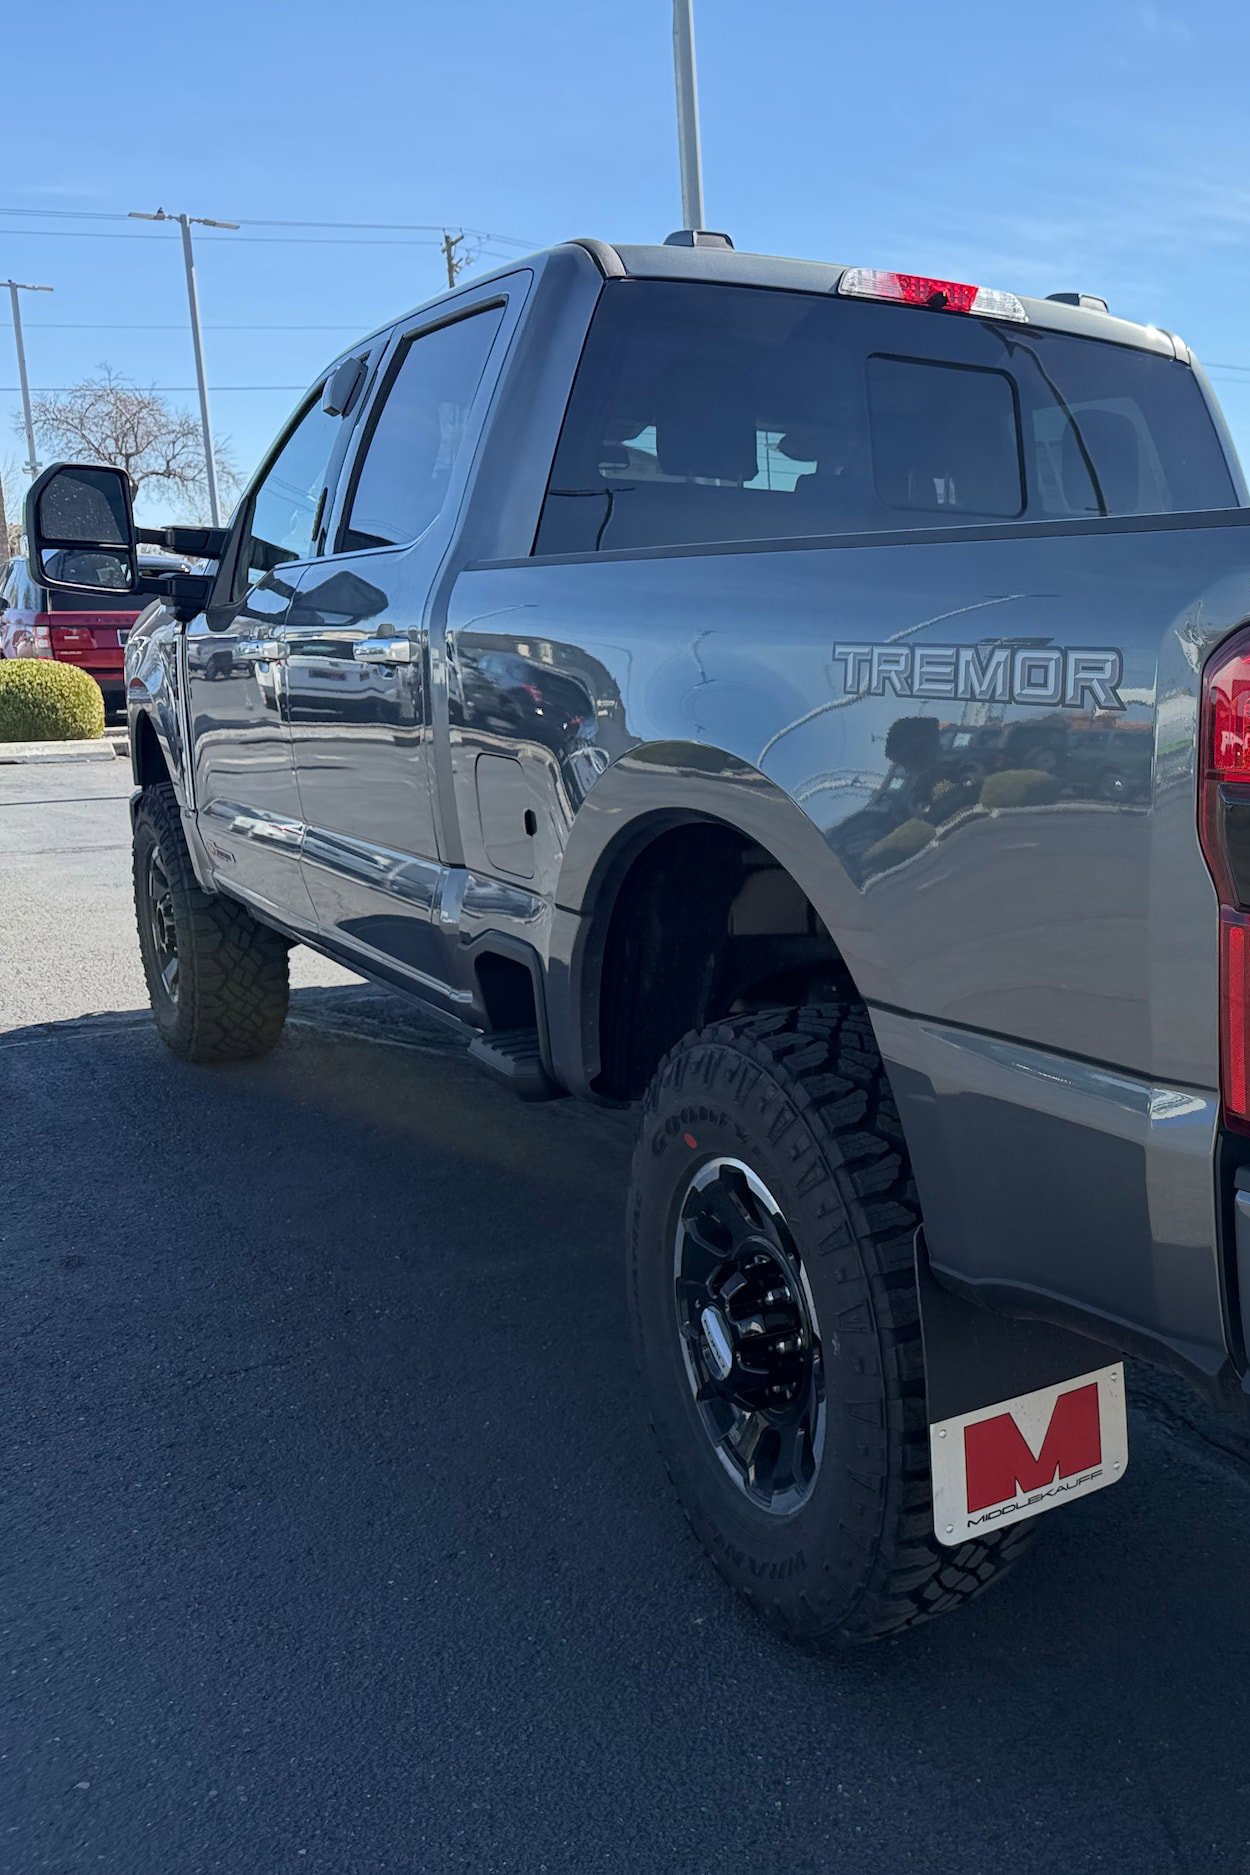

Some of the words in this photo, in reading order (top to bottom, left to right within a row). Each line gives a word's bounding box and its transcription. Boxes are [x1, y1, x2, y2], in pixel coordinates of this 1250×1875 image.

[833, 641, 1127, 711] TREMOR
[964, 1382, 1102, 1514] M
[966, 1469, 1104, 1528] MIDDLEKAUFF
